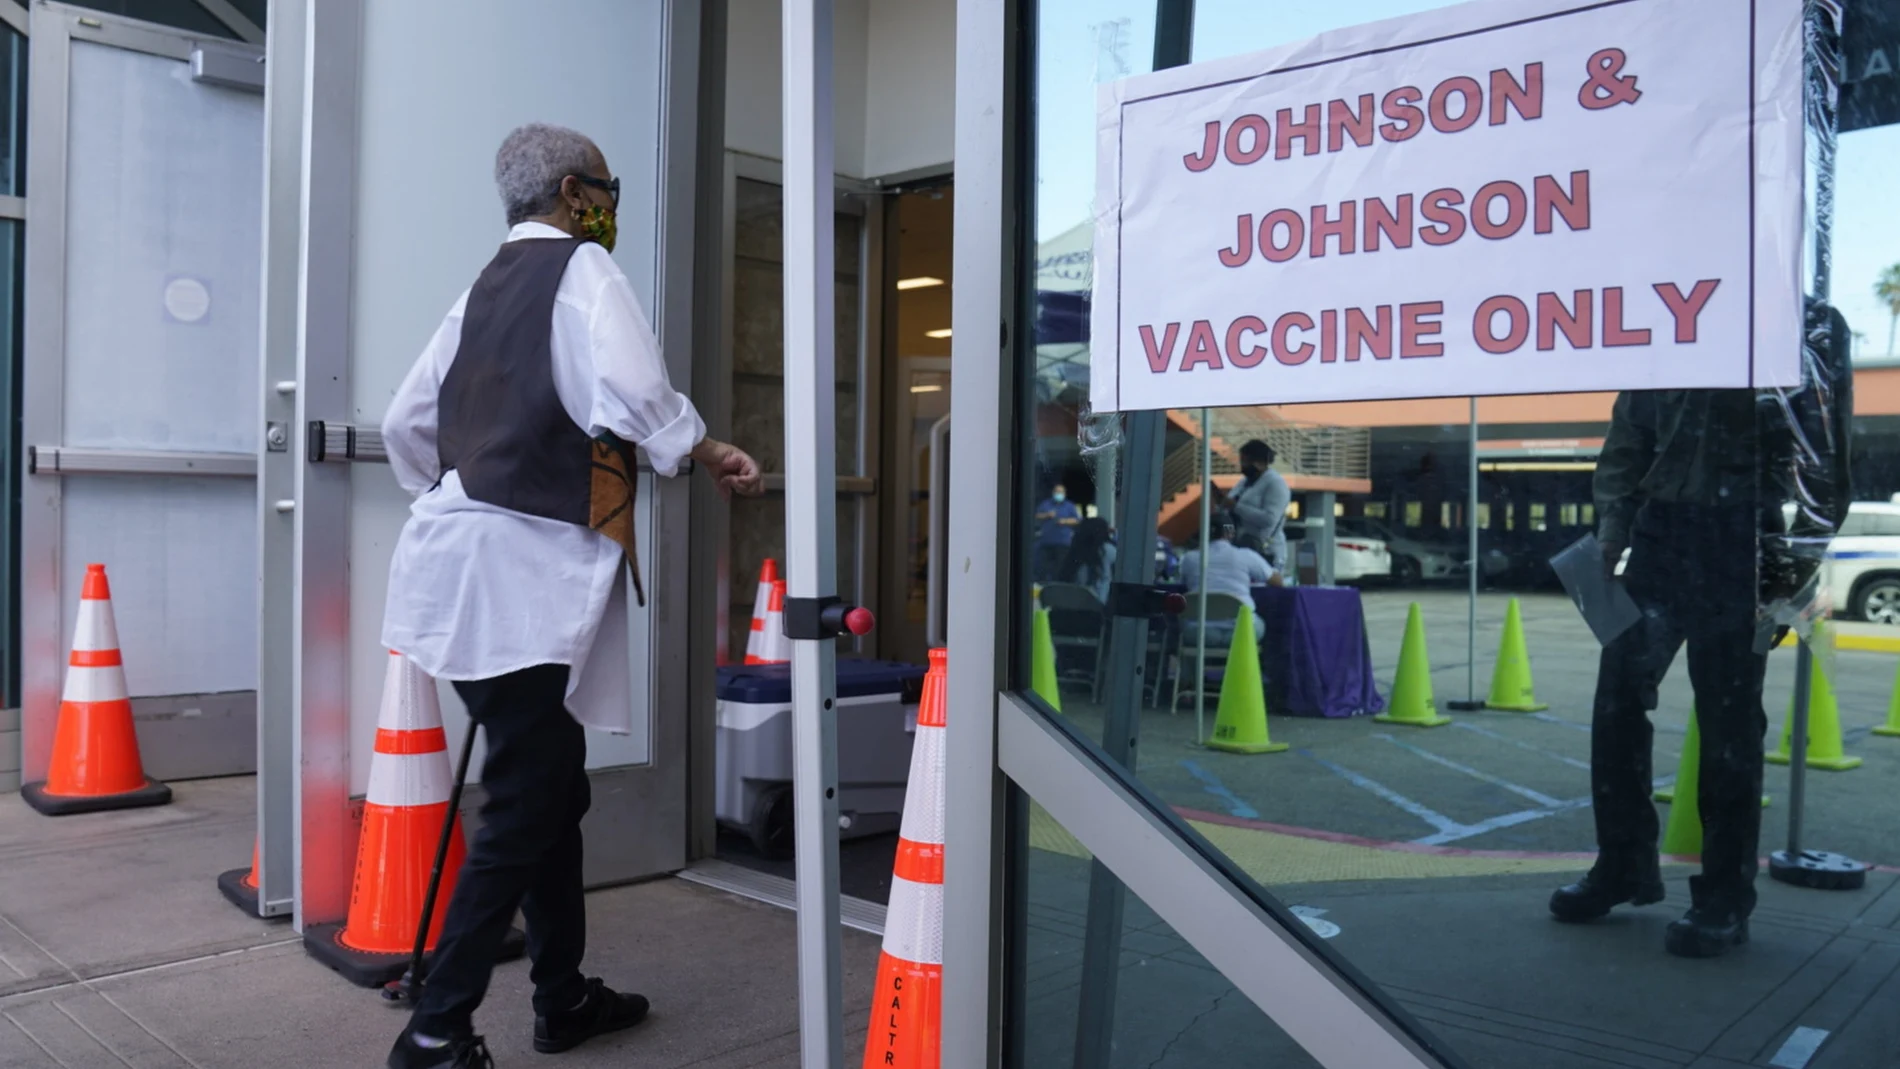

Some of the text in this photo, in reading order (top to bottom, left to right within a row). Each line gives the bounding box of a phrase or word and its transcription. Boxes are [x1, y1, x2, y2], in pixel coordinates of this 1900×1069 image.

[1183, 47, 1643, 172] JOHNSON &
[1218, 169, 1591, 268] JOHNSON
[1138, 278, 1721, 373] VACCINE ONLY
